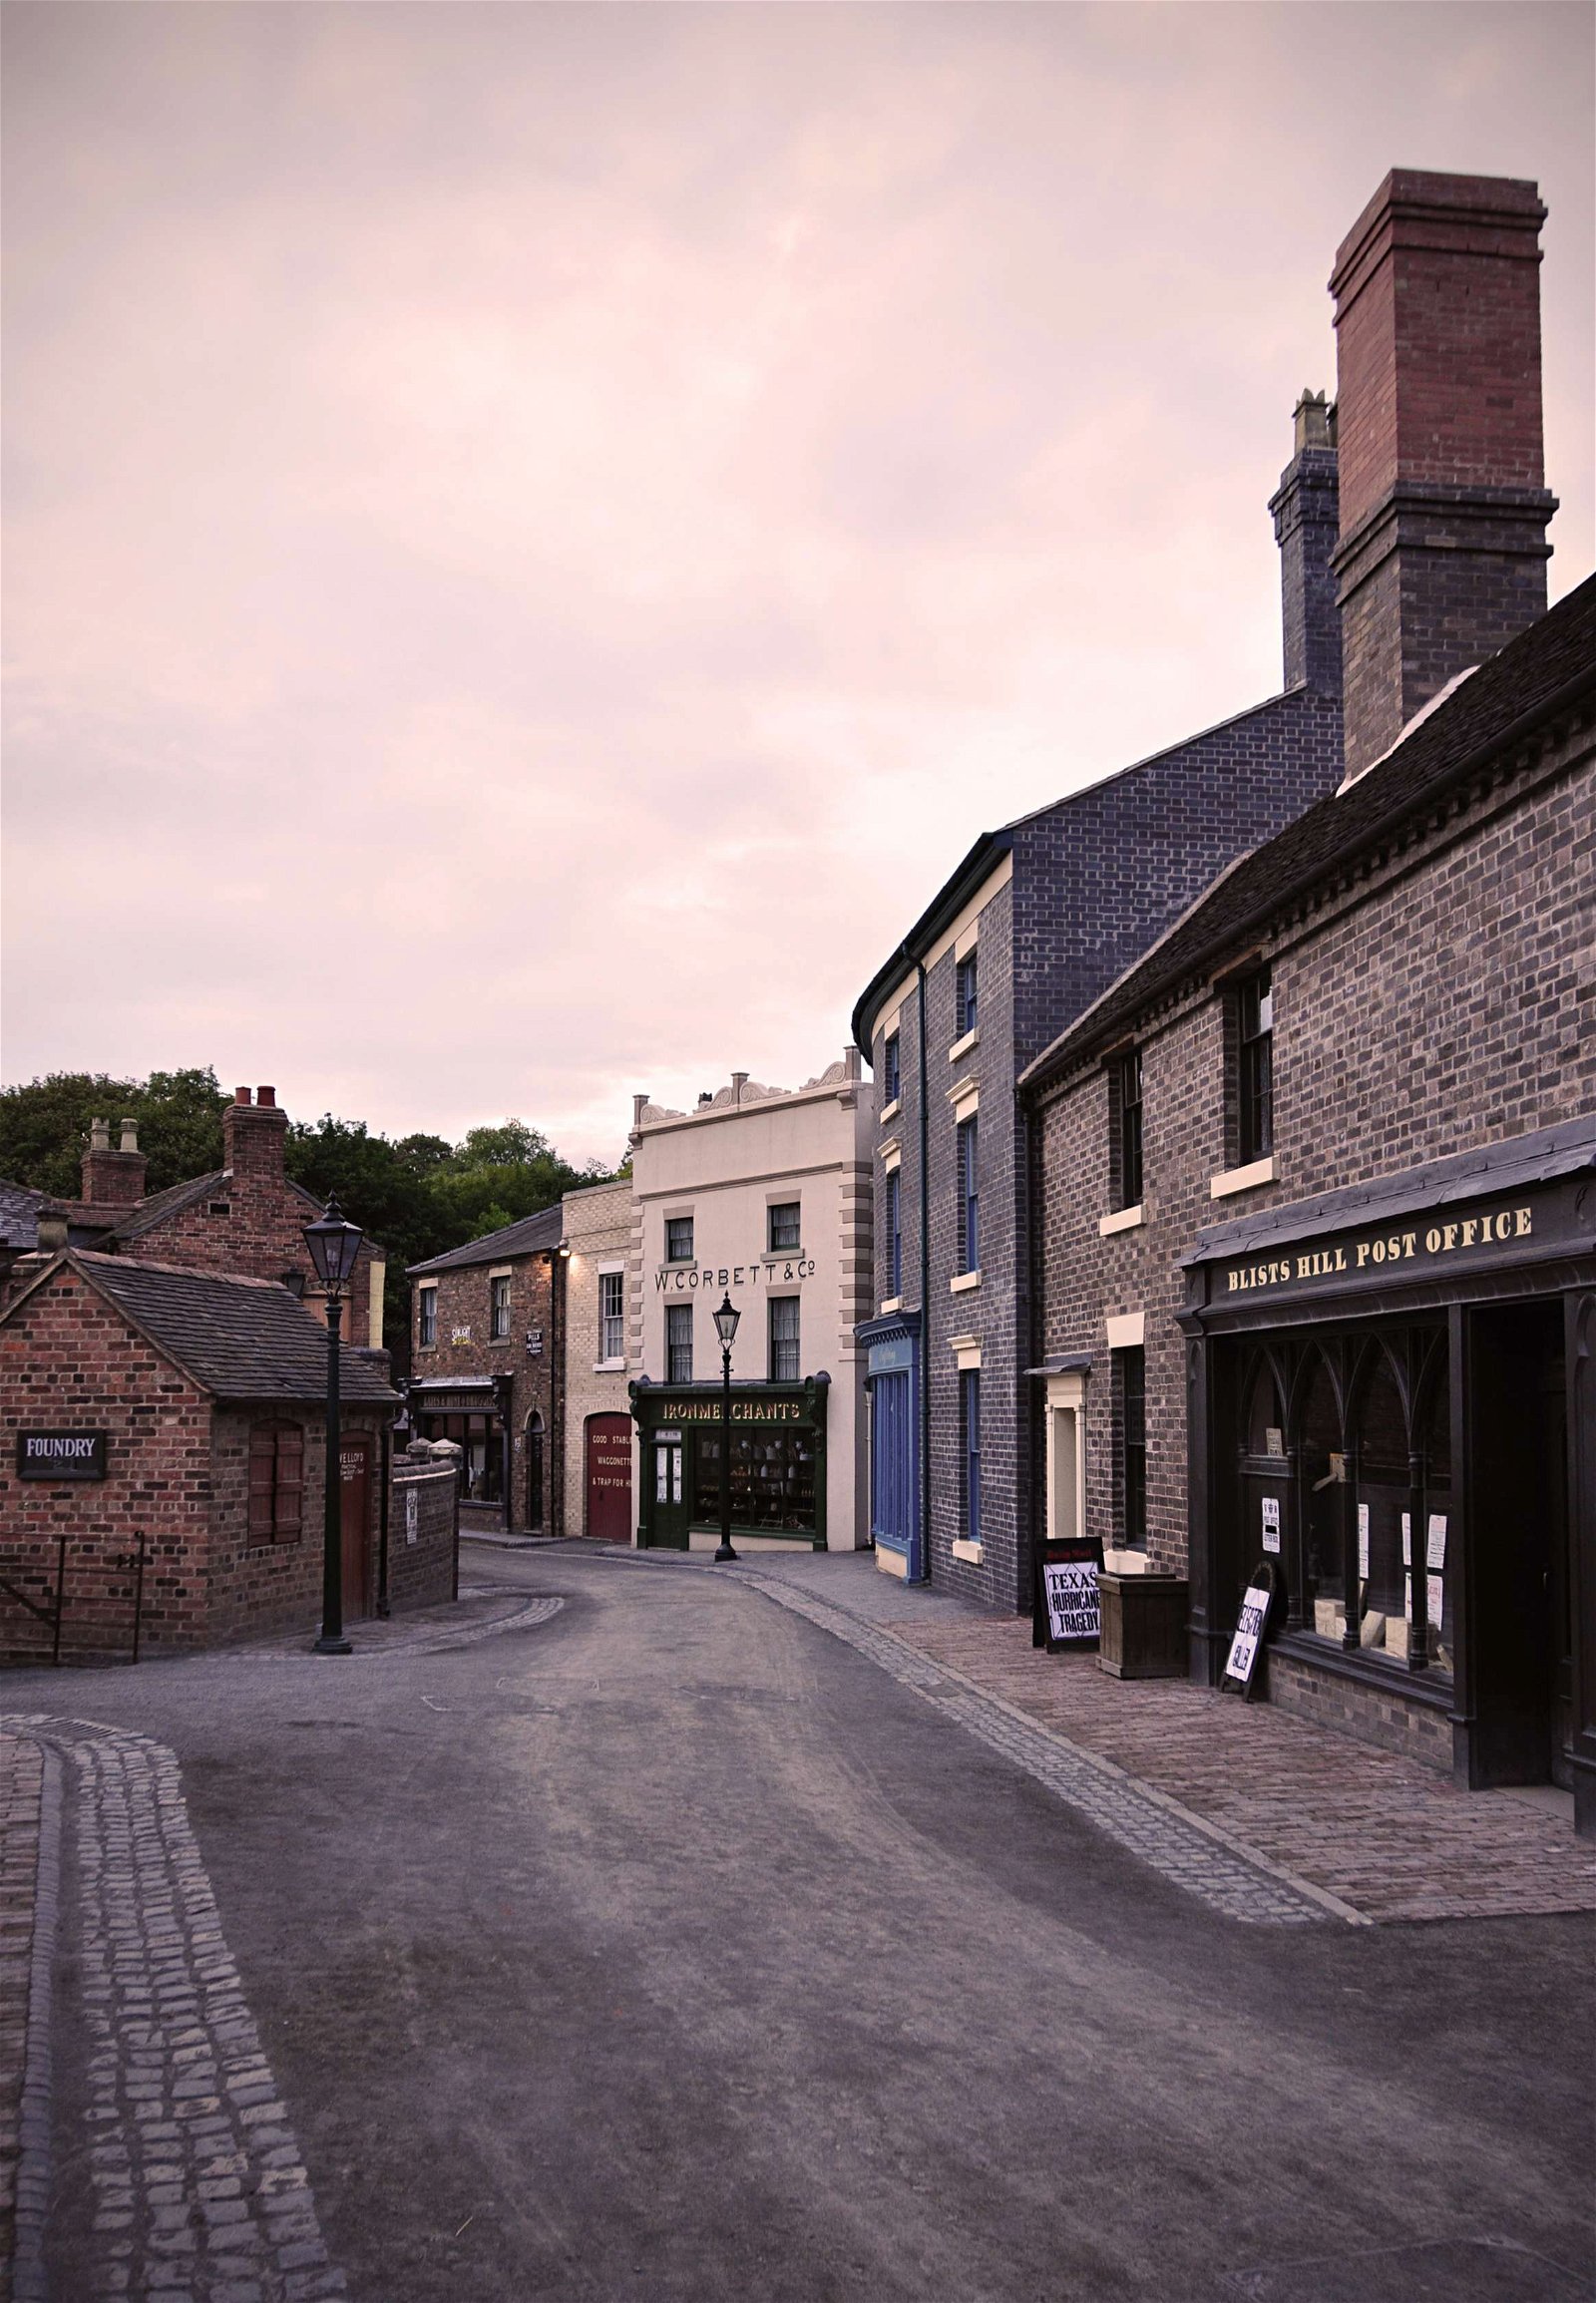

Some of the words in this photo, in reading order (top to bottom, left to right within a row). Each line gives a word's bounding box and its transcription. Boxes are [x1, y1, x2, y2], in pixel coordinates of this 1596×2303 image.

[1228, 1260, 1290, 1292] BLISTS
[1297, 1248, 1347, 1279] HILL
[1357, 1232, 1416, 1267] POST
[1425, 1208, 1532, 1253] OFFICE
[675, 1265, 776, 1290] CORBETT
[783, 1263, 794, 1282] &
[662, 1403, 800, 1419] IRONMECHANTS
[26, 1437, 96, 1457] FOUNDRY
[598, 1477, 611, 1486] TRAP
[612, 1478, 623, 1487] FOR
[1049, 1571, 1097, 1591] TEXAS
[1058, 1611, 1099, 1634] TRAGEDY
